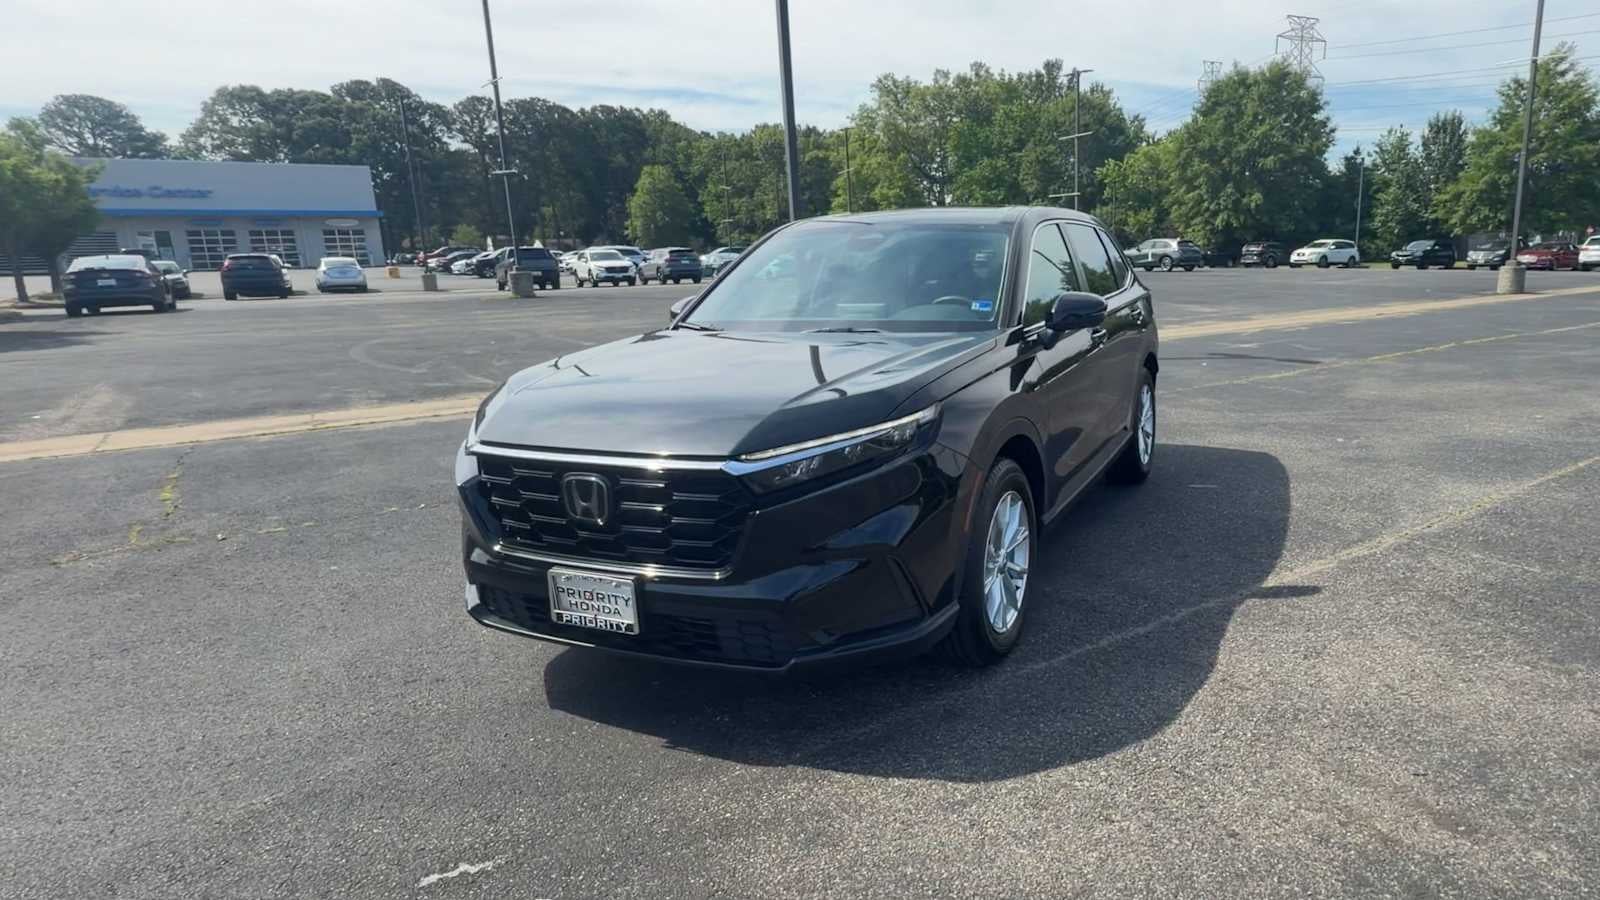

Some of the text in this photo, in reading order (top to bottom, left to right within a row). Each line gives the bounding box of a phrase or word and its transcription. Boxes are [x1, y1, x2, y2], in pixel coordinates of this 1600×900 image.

[556, 586, 631, 606] PRIORITY
[569, 600, 622, 616] HONDA
[563, 615, 627, 632] PRIORITY
